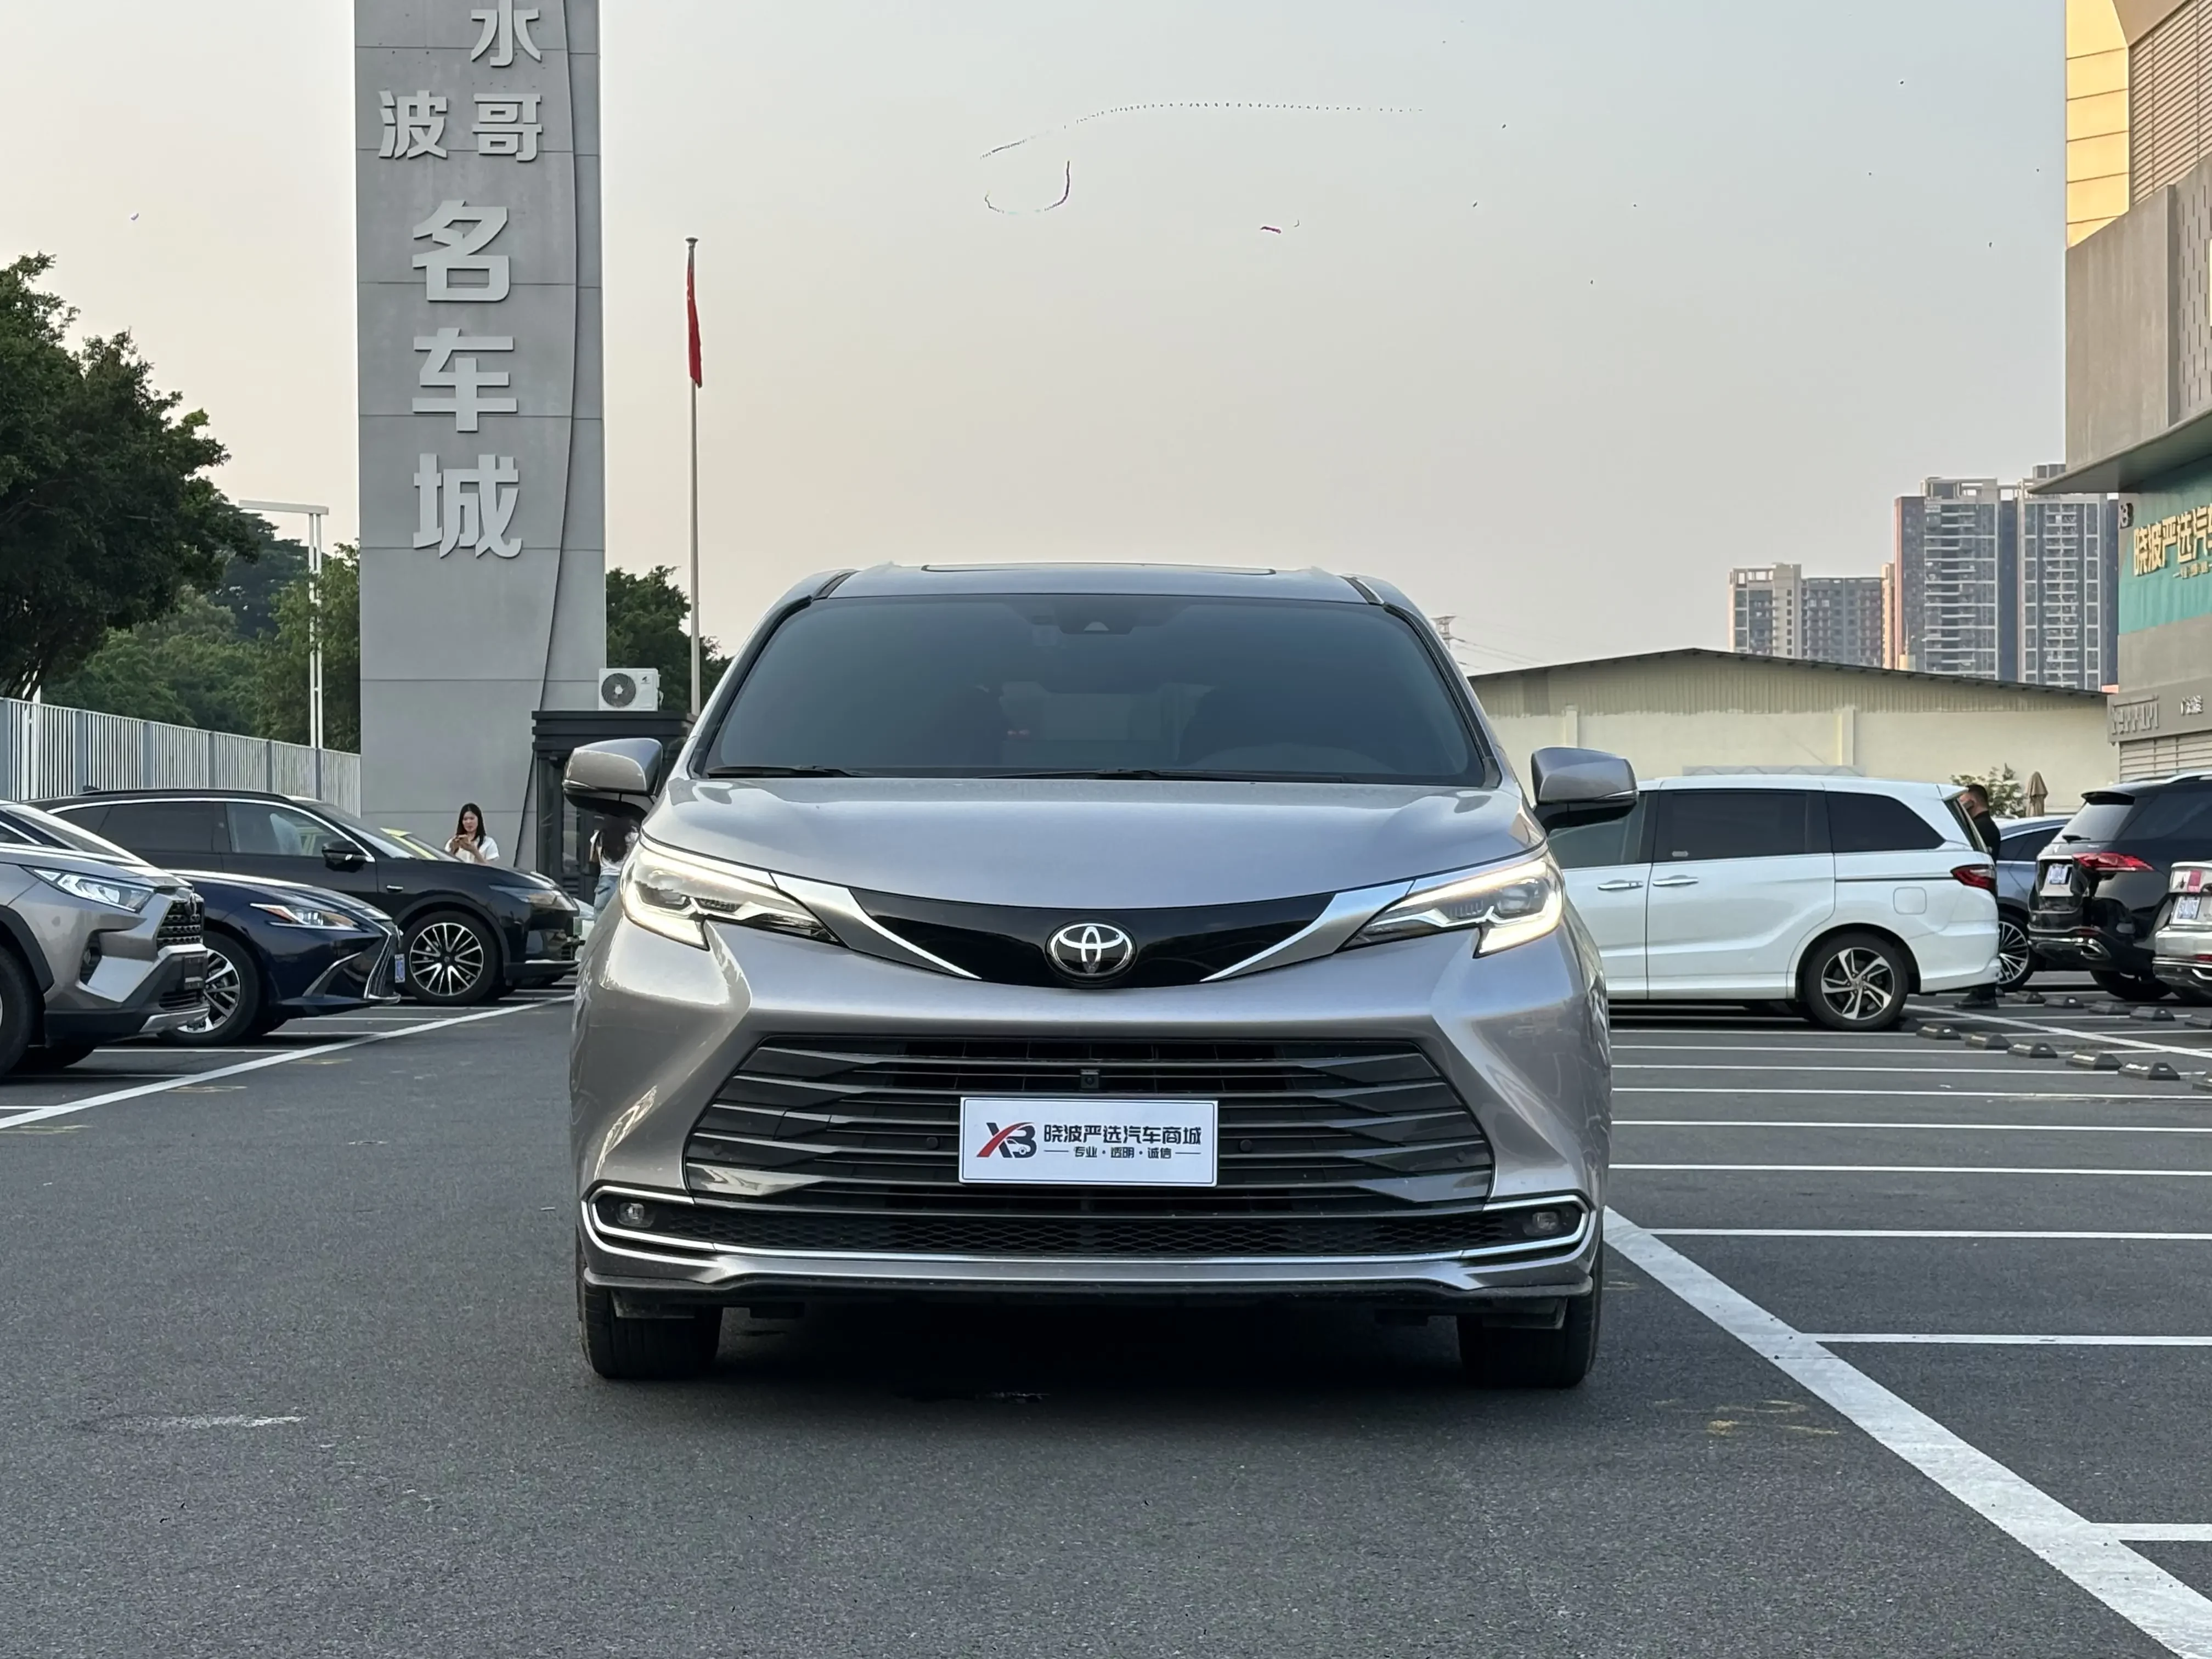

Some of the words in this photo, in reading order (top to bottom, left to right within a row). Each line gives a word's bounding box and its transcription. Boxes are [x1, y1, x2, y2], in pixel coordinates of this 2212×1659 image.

[2134, 503, 2212, 576] 晓波严选汽
[1043, 1124, 1201, 1145] 晓波严选汽车商城
